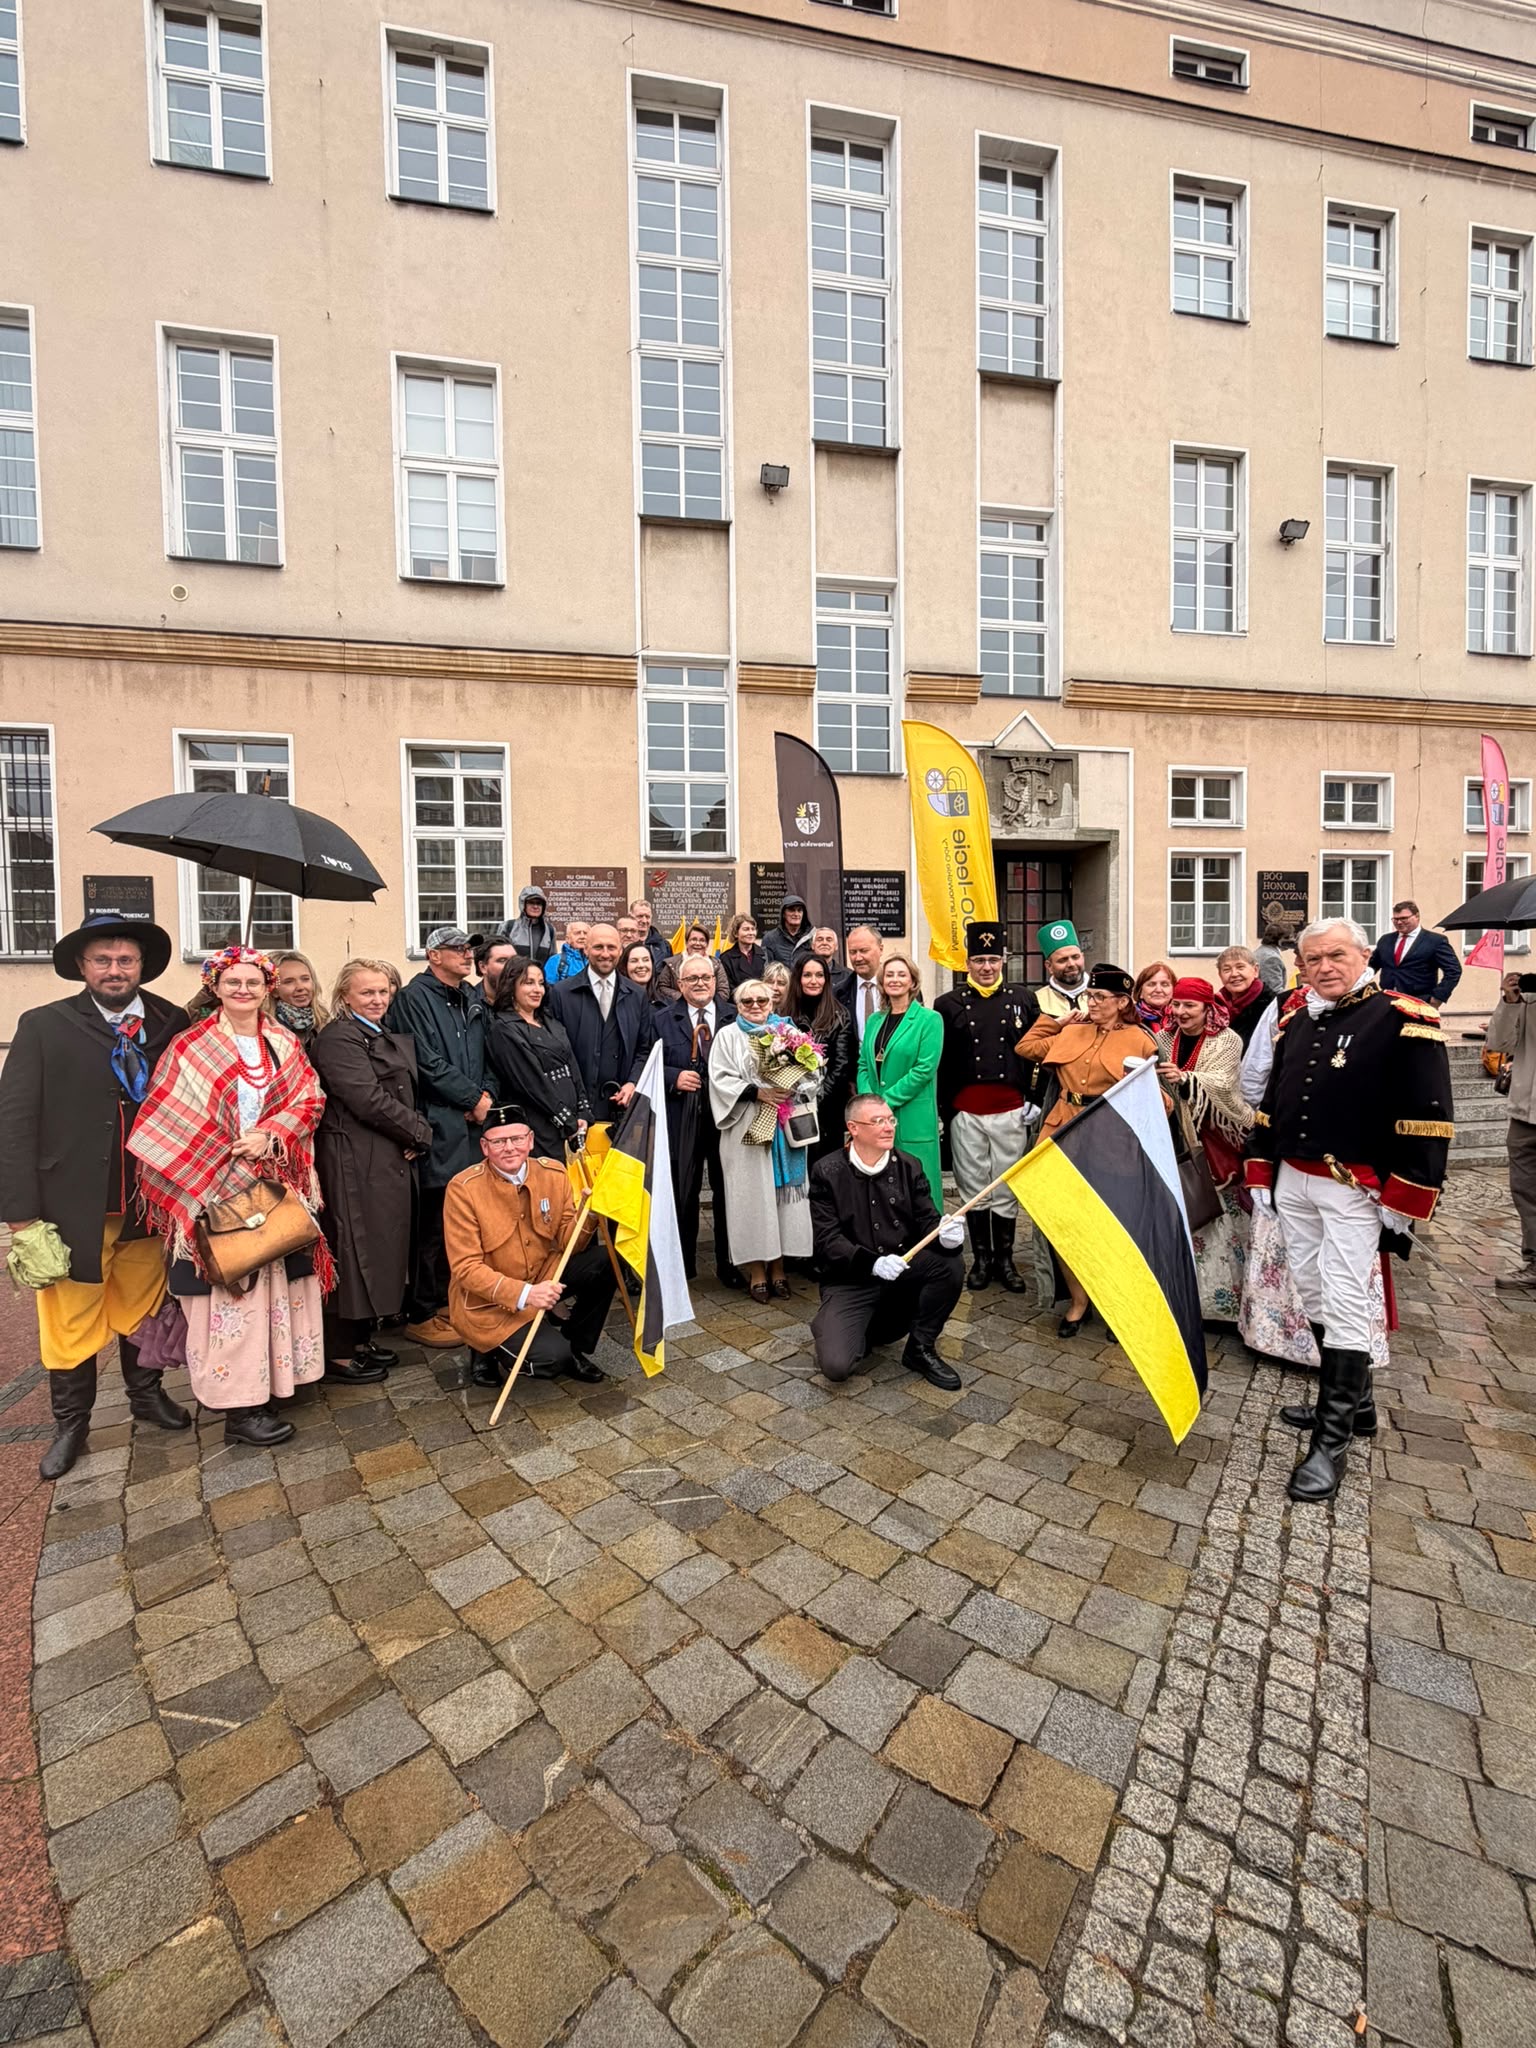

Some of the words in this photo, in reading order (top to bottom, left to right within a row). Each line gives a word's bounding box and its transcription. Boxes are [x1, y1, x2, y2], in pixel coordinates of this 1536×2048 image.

[1263, 872, 1283, 881] BÓG
[1263, 881, 1296, 891] HONOR
[1262, 891, 1309, 900] OJCZYZNA
